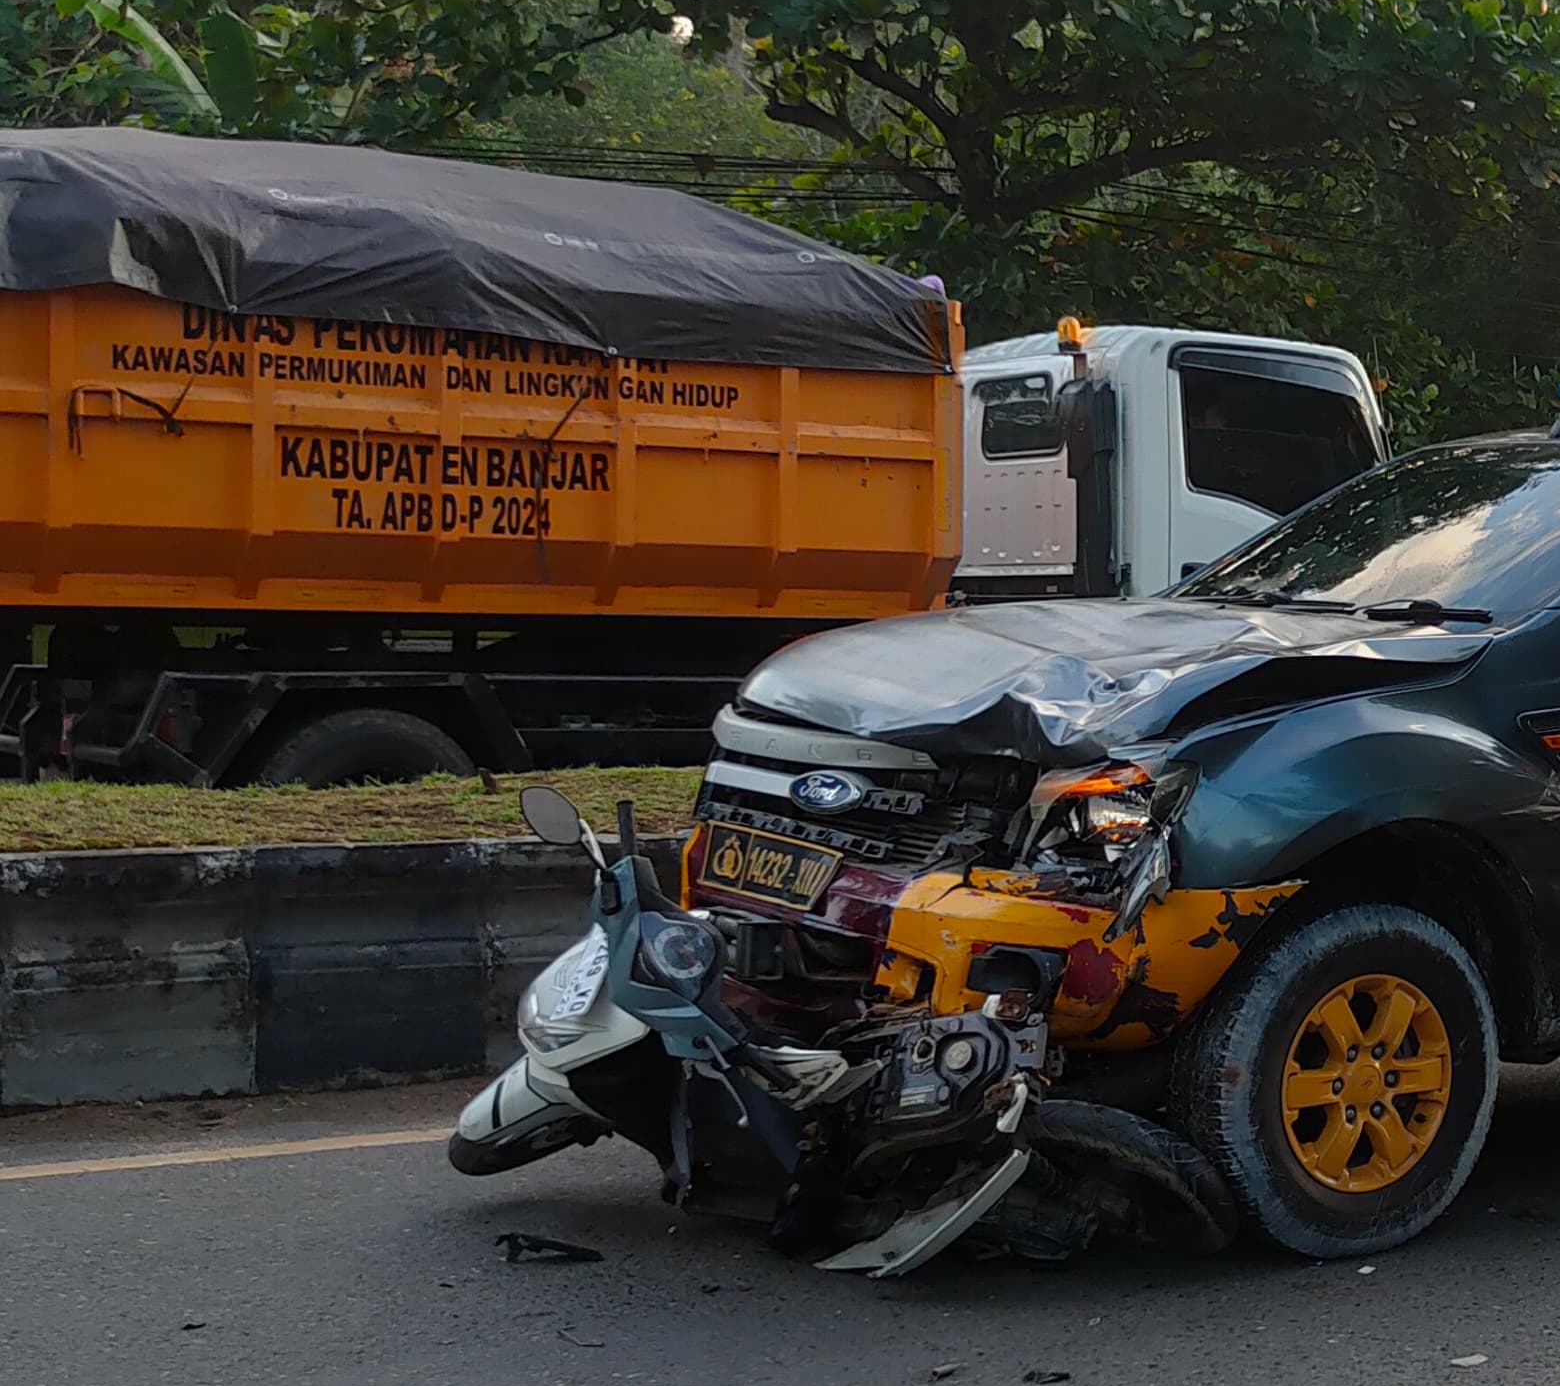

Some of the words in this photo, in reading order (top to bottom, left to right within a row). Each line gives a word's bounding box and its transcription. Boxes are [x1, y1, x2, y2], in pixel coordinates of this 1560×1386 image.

[111, 343, 246, 378] KAWASAN
[258, 352, 427, 389] PERMUKIMAN
[446, 365, 492, 393] DAN
[671, 382, 739, 409] HIDUP
[486, 447, 611, 492] BANJAR
[332, 488, 373, 531] TA.
[491, 496, 551, 537] 2024
[799, 774, 843, 801] Ford
